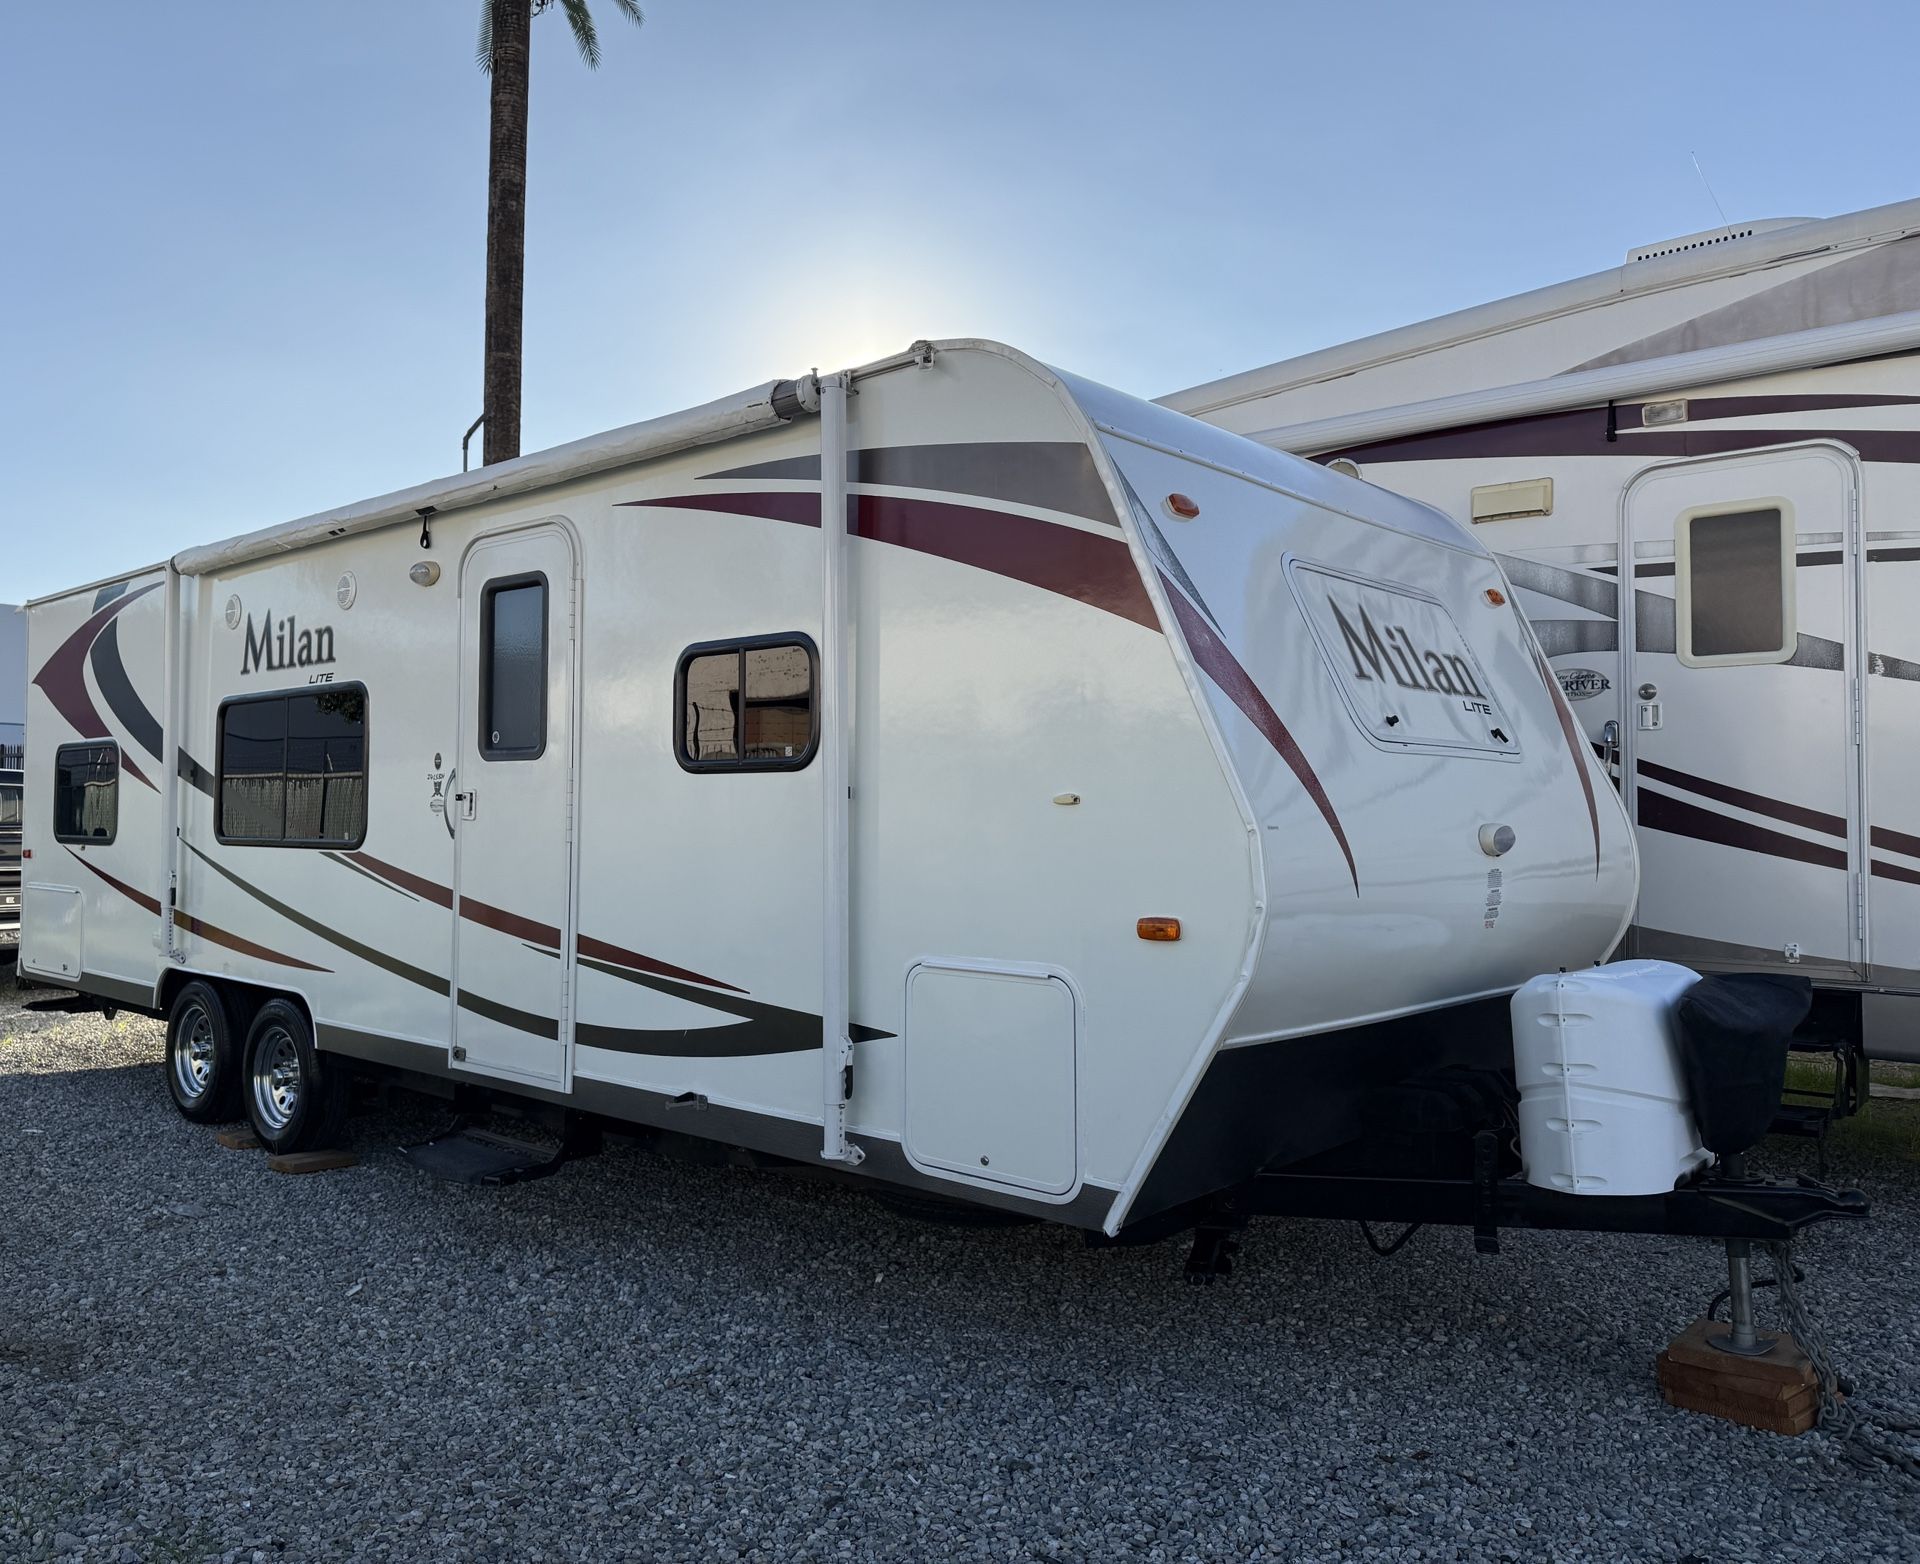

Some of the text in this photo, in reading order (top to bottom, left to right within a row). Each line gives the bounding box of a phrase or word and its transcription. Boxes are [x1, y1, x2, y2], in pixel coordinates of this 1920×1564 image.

[240, 607, 337, 676] Milan
[1327, 593, 1488, 700] Milan
[308, 672, 335, 685] LITE
[1565, 679, 1612, 691] RIVER
[1462, 700, 1492, 716] LITE
